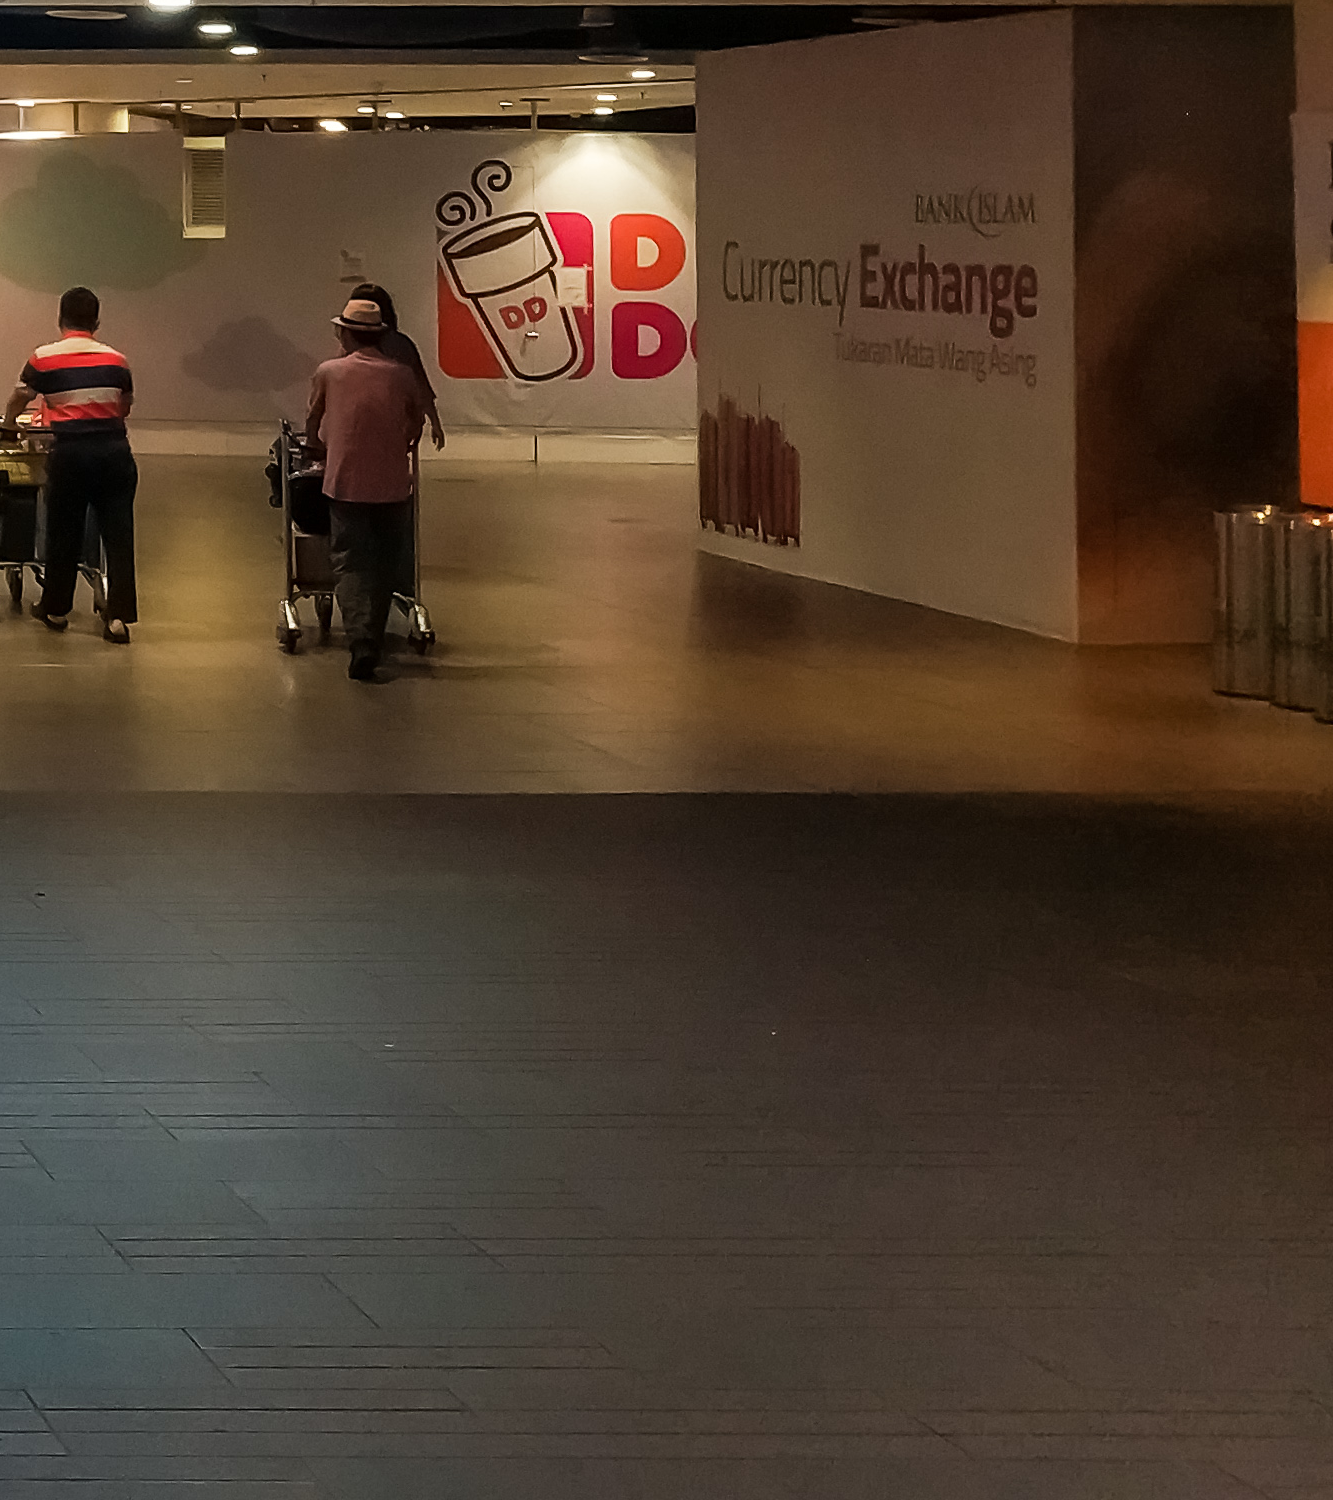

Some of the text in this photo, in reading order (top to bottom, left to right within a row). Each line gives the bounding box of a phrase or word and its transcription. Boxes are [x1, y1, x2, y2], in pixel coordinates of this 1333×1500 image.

[915, 193, 1037, 224] BANK ISLAM
[499, 296, 548, 330] DD
[722, 241, 1038, 339] Currency Exchange
[611, 301, 697, 379] D
[833, 332, 1038, 388] Tukaran Mata Wang Asing
